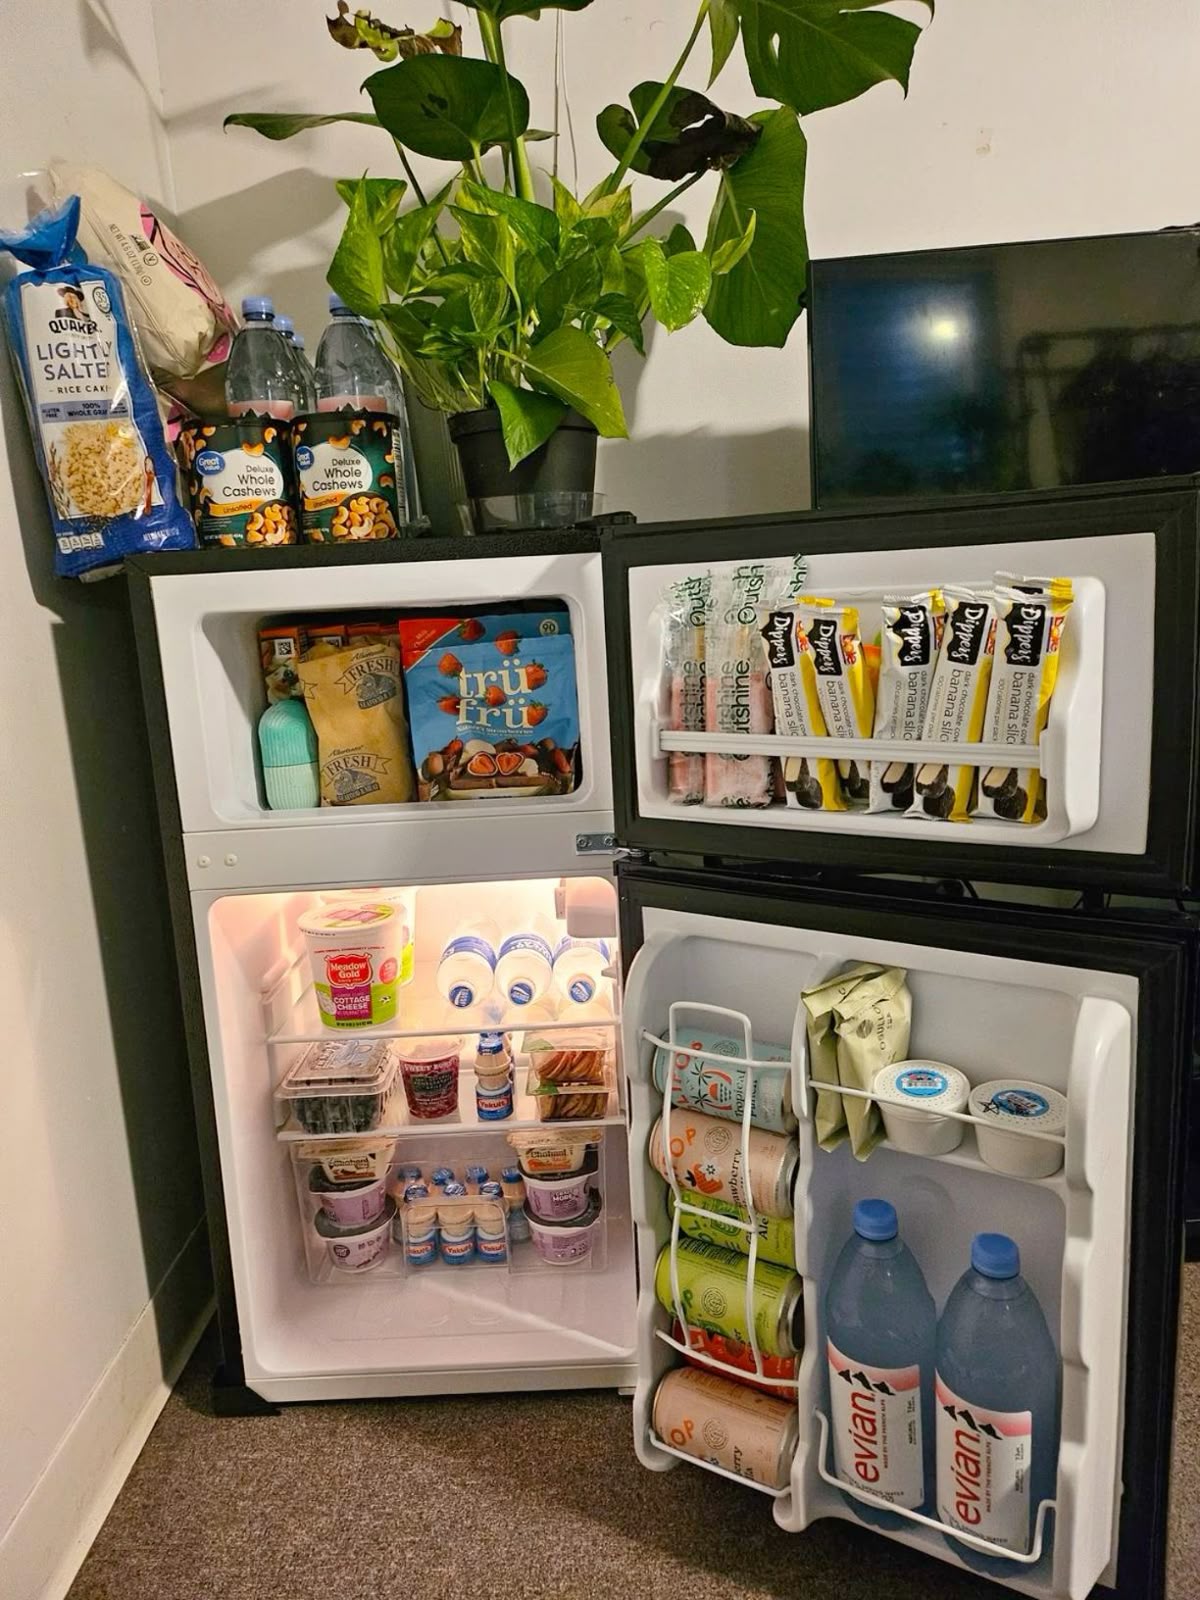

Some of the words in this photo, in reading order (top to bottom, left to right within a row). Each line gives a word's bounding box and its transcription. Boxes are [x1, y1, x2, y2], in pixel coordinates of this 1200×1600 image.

[49, 319, 98, 335] QUAKER
[36, 341, 112, 361] LIGHTLY
[44, 362, 110, 382] SALTE
[57, 386, 82, 394] RICE
[67, 409, 92, 417] WHOLE
[82, 402, 101, 410] 100%
[199, 456, 220, 467] Great
[245, 464, 275, 473] Deluxe
[331, 458, 361, 466] Deluxe
[237, 474, 275, 486] Whole
[323, 467, 362, 479] Whole
[222, 486, 277, 497] Cashews
[312, 480, 364, 492] Cashews
[769, 616, 791, 665] Dippers
[902, 610, 926, 662] Dippers
[951, 607, 984, 661] Dippers
[1011, 606, 1042, 662] Dippers
[814, 624, 836, 673] Dippers
[349, 656, 394, 681] FRESH
[459, 658, 535, 699] trü
[1027, 672, 1036, 689] dark
[778, 673, 793, 718] banana
[826, 680, 842, 722] banana
[905, 671, 920, 718] banana
[943, 669, 962, 717] banana
[1007, 671, 1026, 720] banana
[455, 697, 534, 729] frü
[791, 689, 805, 723] chocolate
[955, 689, 969, 726] chocolate
[1022, 690, 1034, 729] chocolate
[327, 755, 372, 775] FRESH
[330, 961, 367, 970] Meadow
[338, 969, 361, 979] Gold
[334, 995, 371, 1005] COTTAGE
[337, 1003, 369, 1011] CHEESE
[758, 1216, 770, 1240] Ale
[848, 1391, 880, 1483] evian
[950, 1430, 981, 1525] evian
